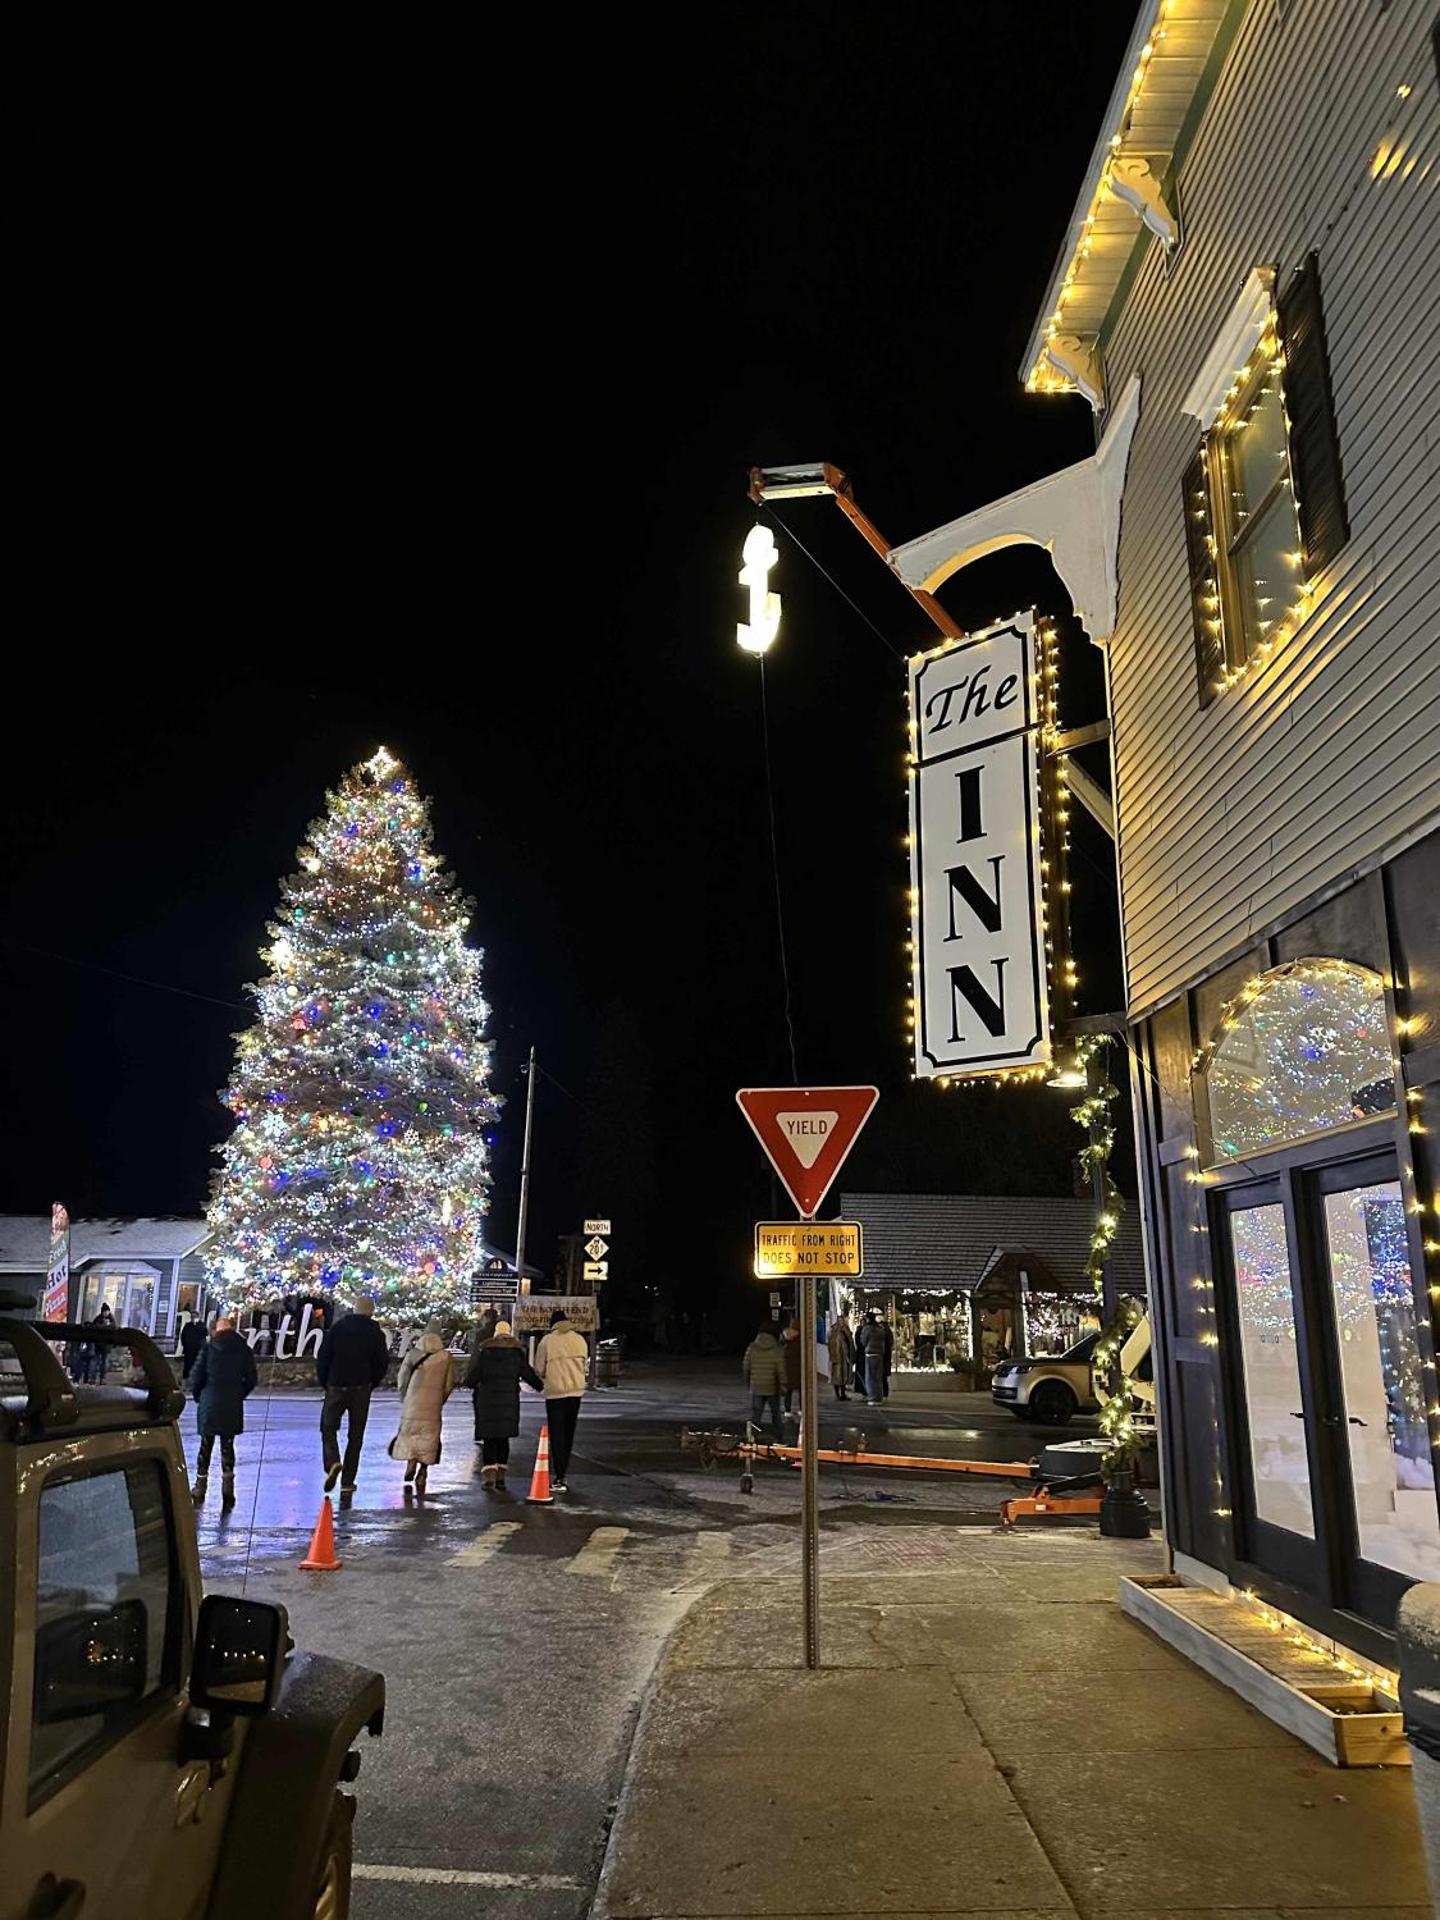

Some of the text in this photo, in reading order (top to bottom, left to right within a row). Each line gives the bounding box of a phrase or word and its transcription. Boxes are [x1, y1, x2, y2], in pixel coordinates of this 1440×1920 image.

[925, 664, 1018, 734] The
[943, 765, 1009, 1043] INN
[787, 1120, 828, 1135] YIELD
[586, 1223, 609, 1232] NORTH
[762, 1234, 855, 1247] TRAFFIC FROM RIGHT
[763, 1252, 855, 1265] DOES NOT STOP
[47, 1265, 67, 1290] Hot
